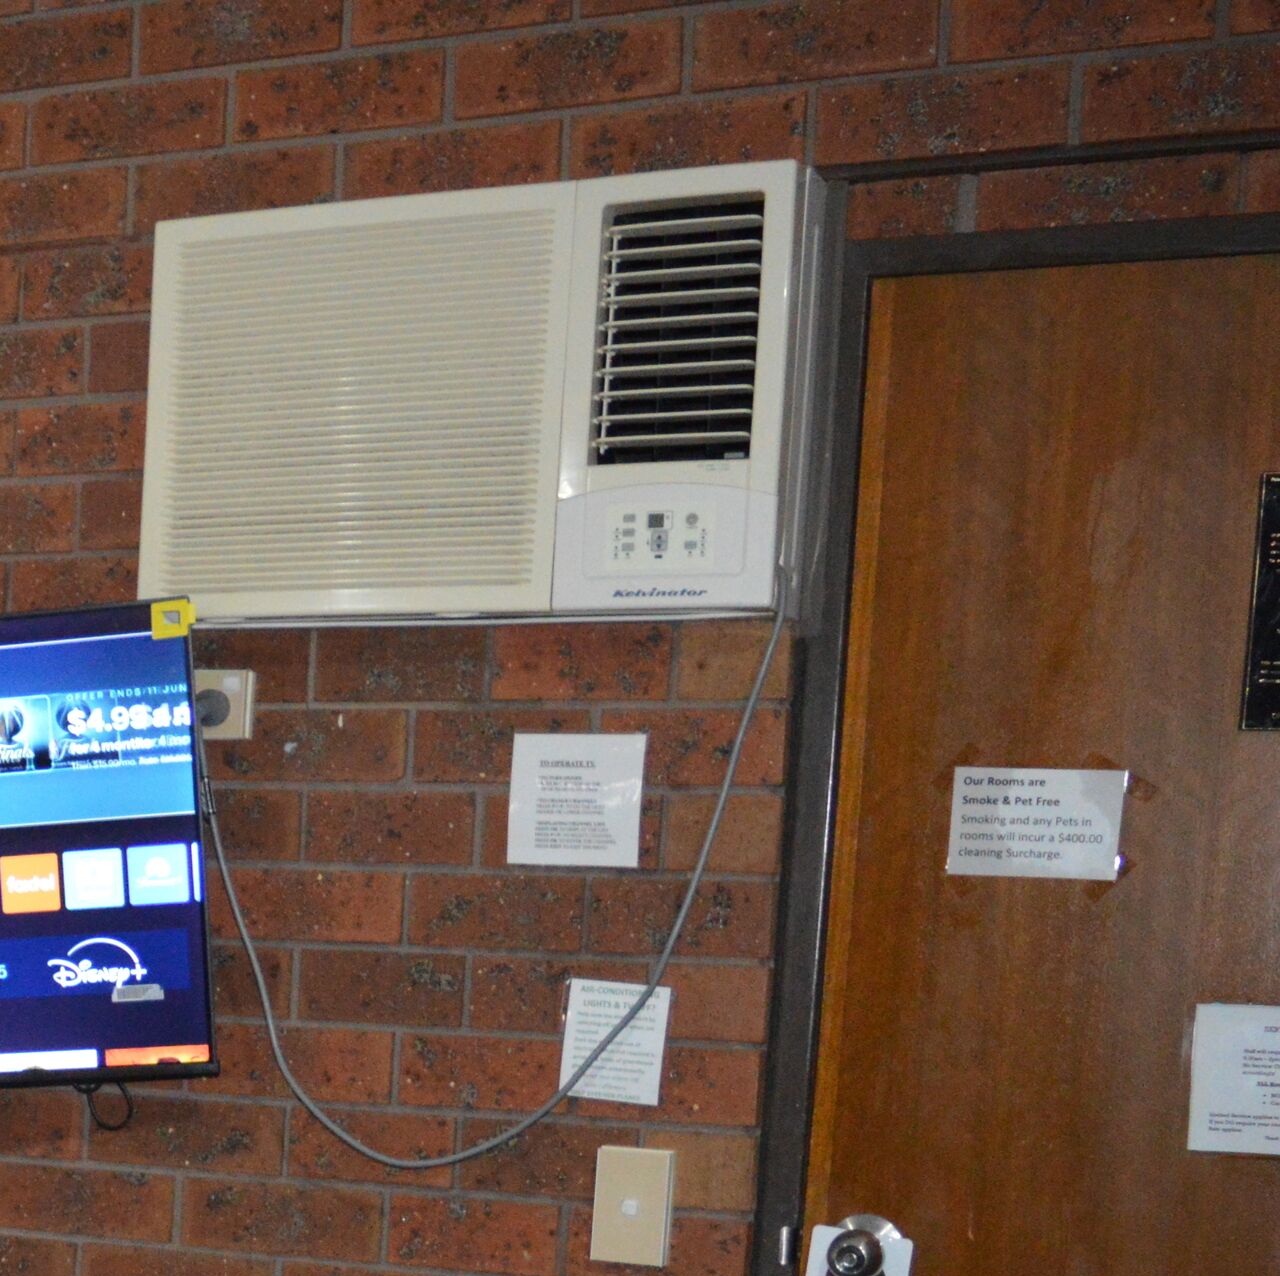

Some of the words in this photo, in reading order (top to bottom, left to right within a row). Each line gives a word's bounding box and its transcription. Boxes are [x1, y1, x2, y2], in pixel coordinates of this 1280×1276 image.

[612, 587, 708, 598] Kelvinator
[963, 776, 983, 787] Our
[987, 776, 1025, 787] Rooms
[1028, 778, 1046, 787] are
[962, 795, 999, 806] Smoke
[1002, 796, 1011, 806] &
[1014, 796, 1032, 806] Pet
[1036, 797, 1060, 807] Free
[961, 814, 1006, 826] Smoking
[1009, 815, 1030, 826] and
[1033, 818, 1052, 828] any
[1055, 817, 1079, 826] Pets
[1081, 817, 1092, 827] in
[959, 833, 993, 842] rooms
[996, 832, 1015, 842] will
[1018, 833, 1045, 843] incur
[1048, 835, 1055, 843] a
[1058, 832, 1104, 844] $400.00
[958, 847, 1003, 860] cleaning
[1006, 848, 1062, 861] Surcharge.
[47, 948, 148, 988] Disney+
[581, 985, 660, 999] AIR-CONDITIOG
